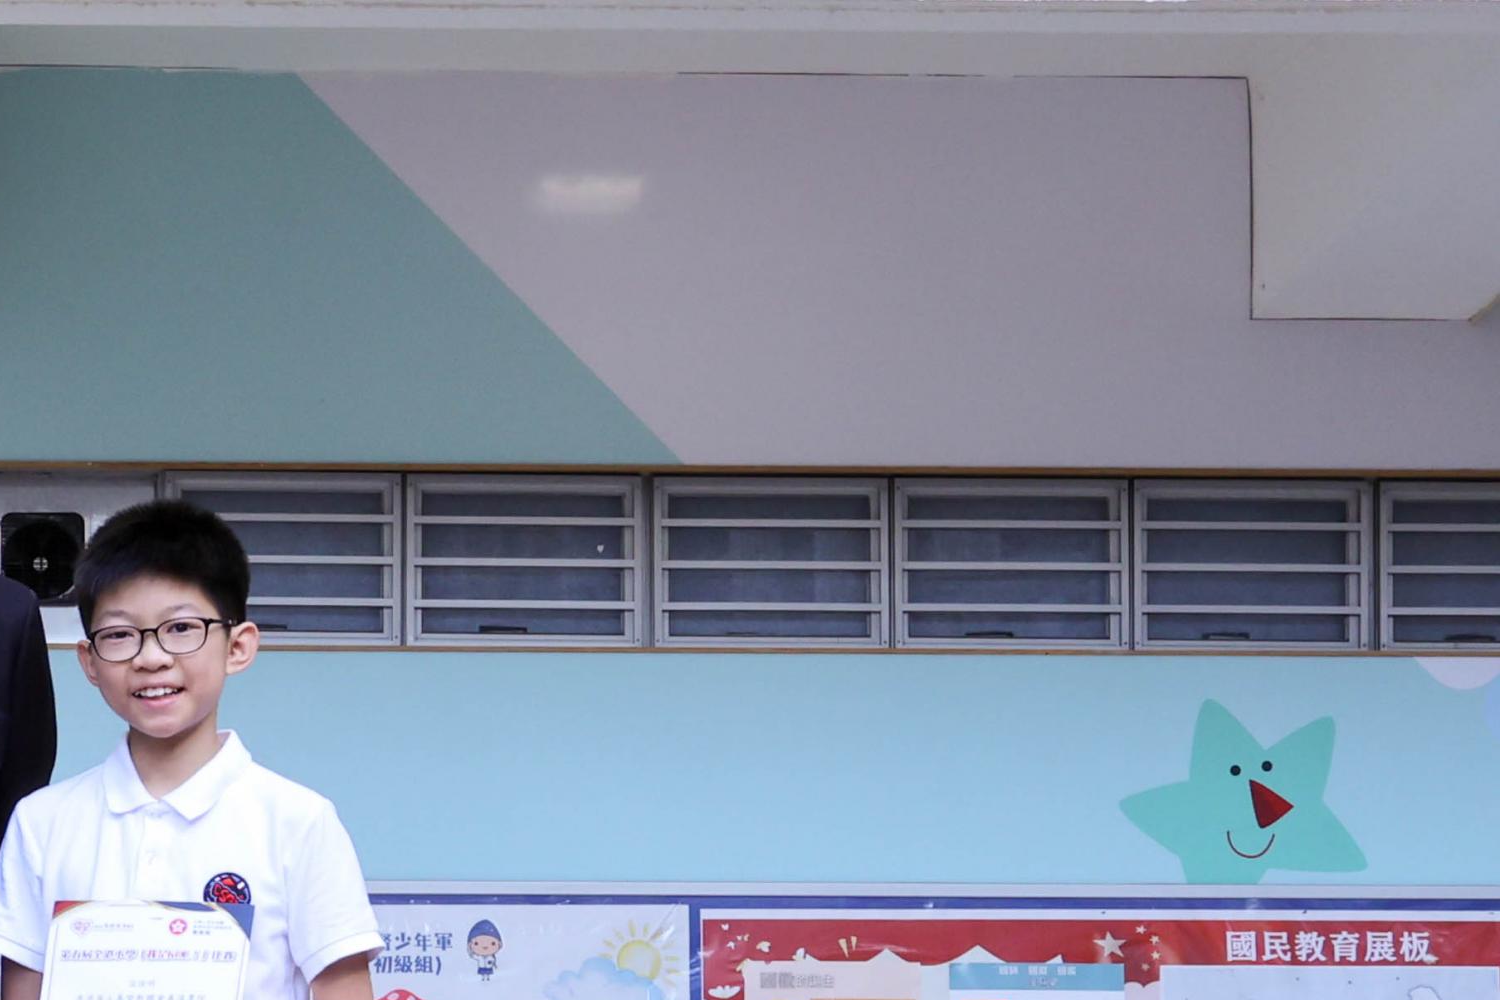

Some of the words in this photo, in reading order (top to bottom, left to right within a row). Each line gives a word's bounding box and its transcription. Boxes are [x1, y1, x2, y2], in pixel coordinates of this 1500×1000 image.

[1225, 930, 1433, 962] 國民教育展板
